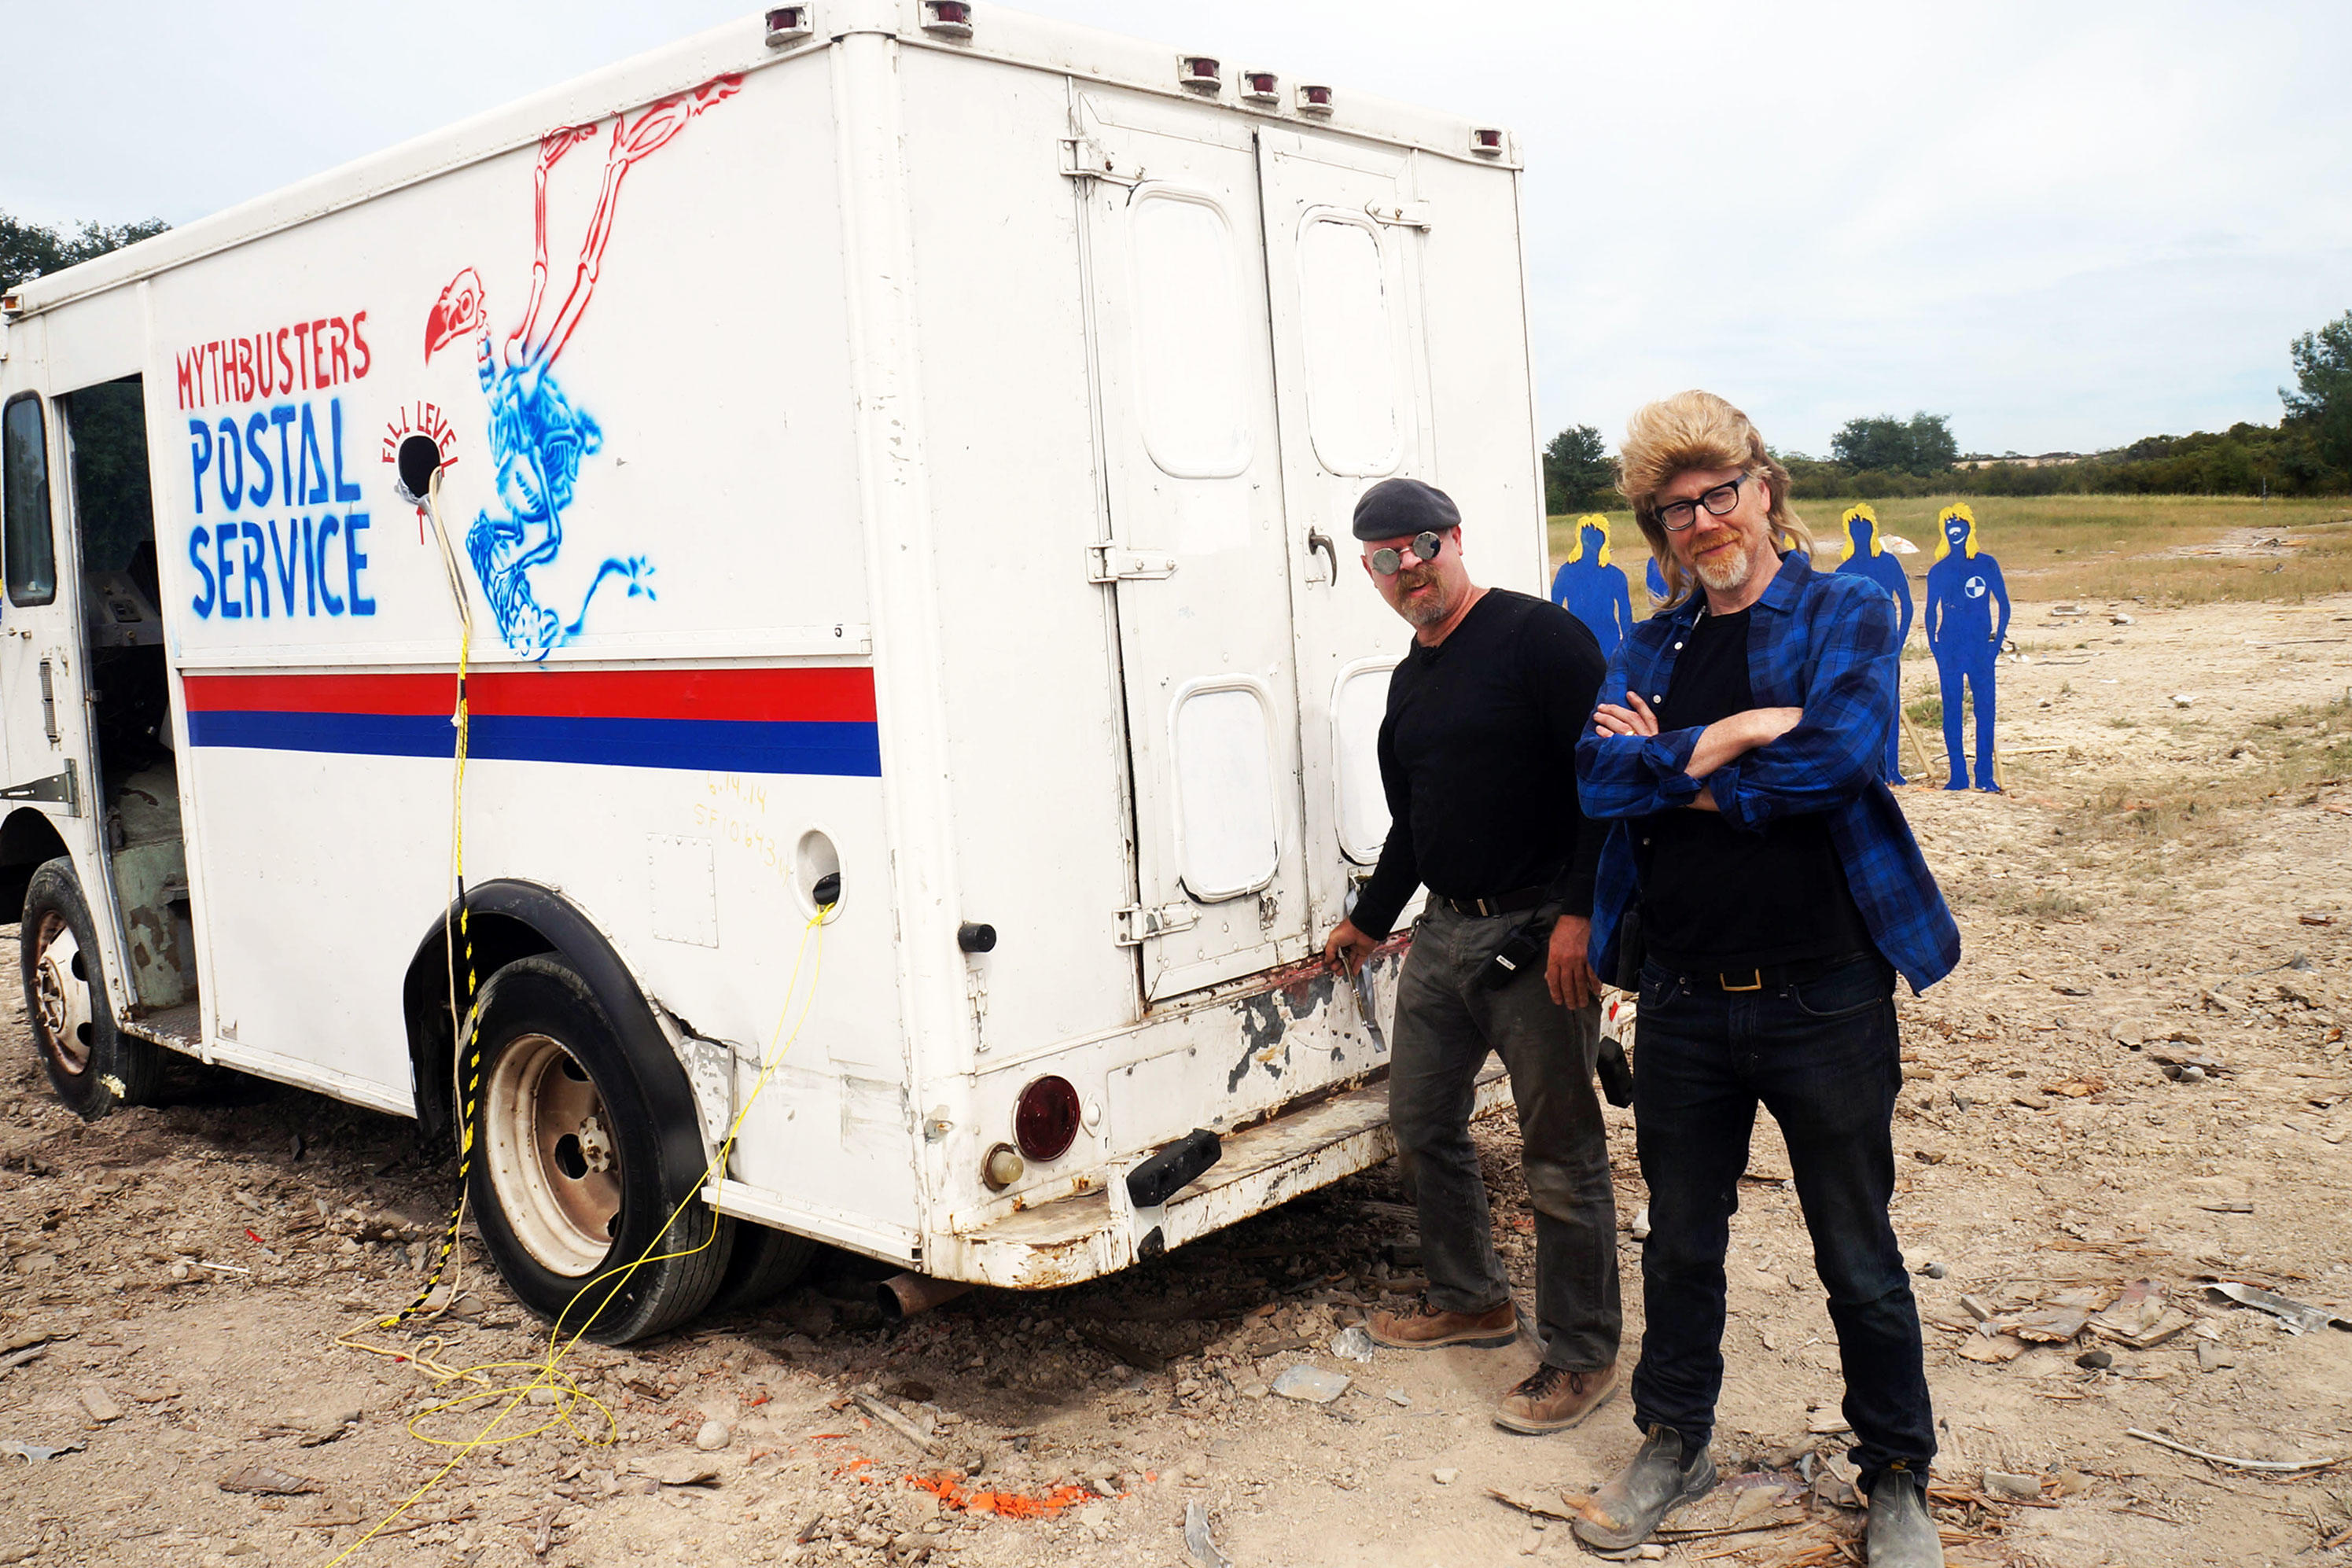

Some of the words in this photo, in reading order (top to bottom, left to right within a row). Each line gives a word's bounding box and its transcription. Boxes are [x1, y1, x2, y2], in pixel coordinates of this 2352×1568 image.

[176, 310, 370, 410] MYTHBUSTERS
[189, 398, 361, 513] POSTAL
[382, 406, 410, 462] FILL
[417, 400, 458, 477] LEVEL
[189, 513, 376, 619] SERVICE
